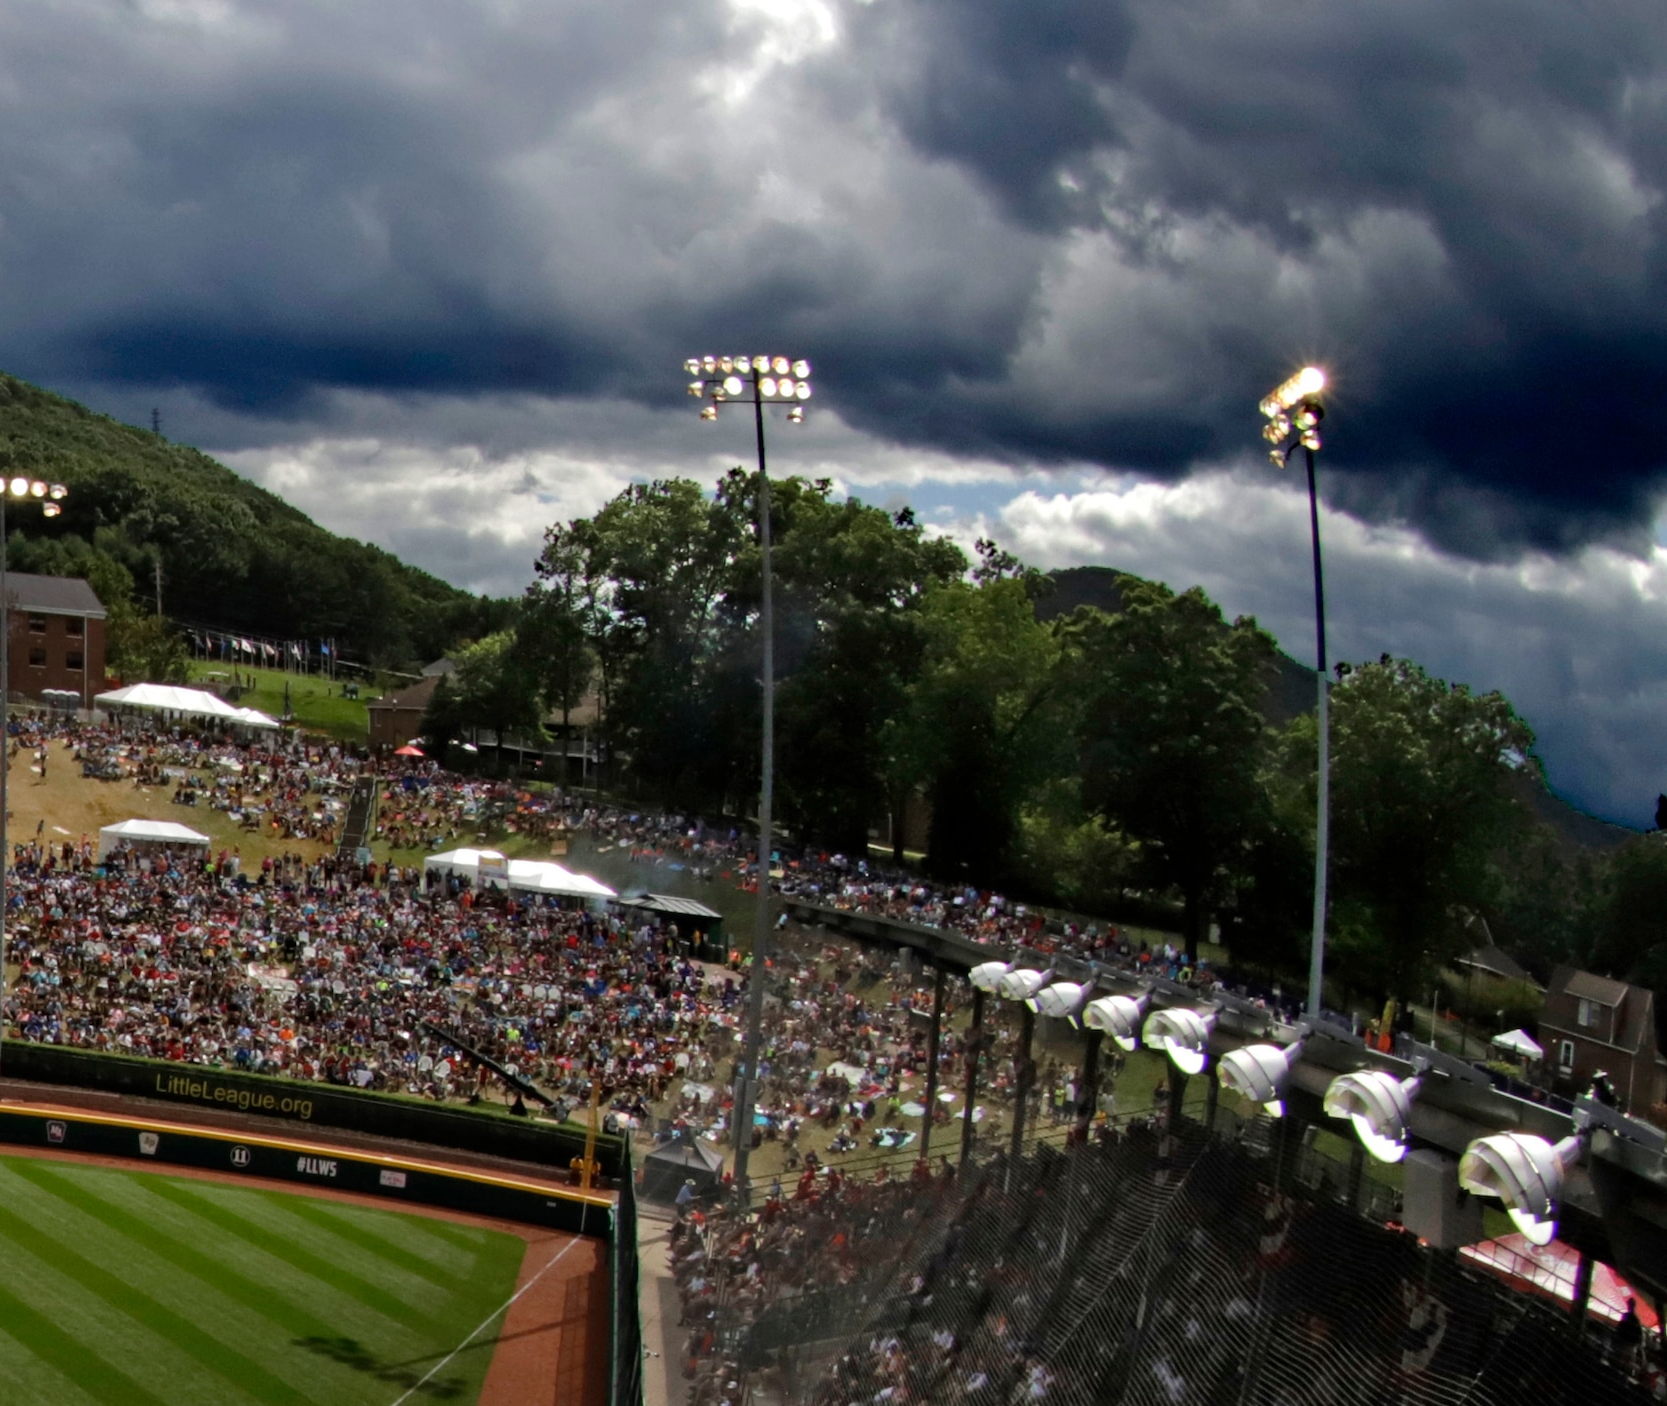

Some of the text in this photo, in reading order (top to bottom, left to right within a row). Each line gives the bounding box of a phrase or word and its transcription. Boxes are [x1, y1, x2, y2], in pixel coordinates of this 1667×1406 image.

[155, 1073, 313, 1120] LittleLeague.org
[233, 1150, 247, 1164] 11
[296, 1156, 338, 1178] #LLWS
